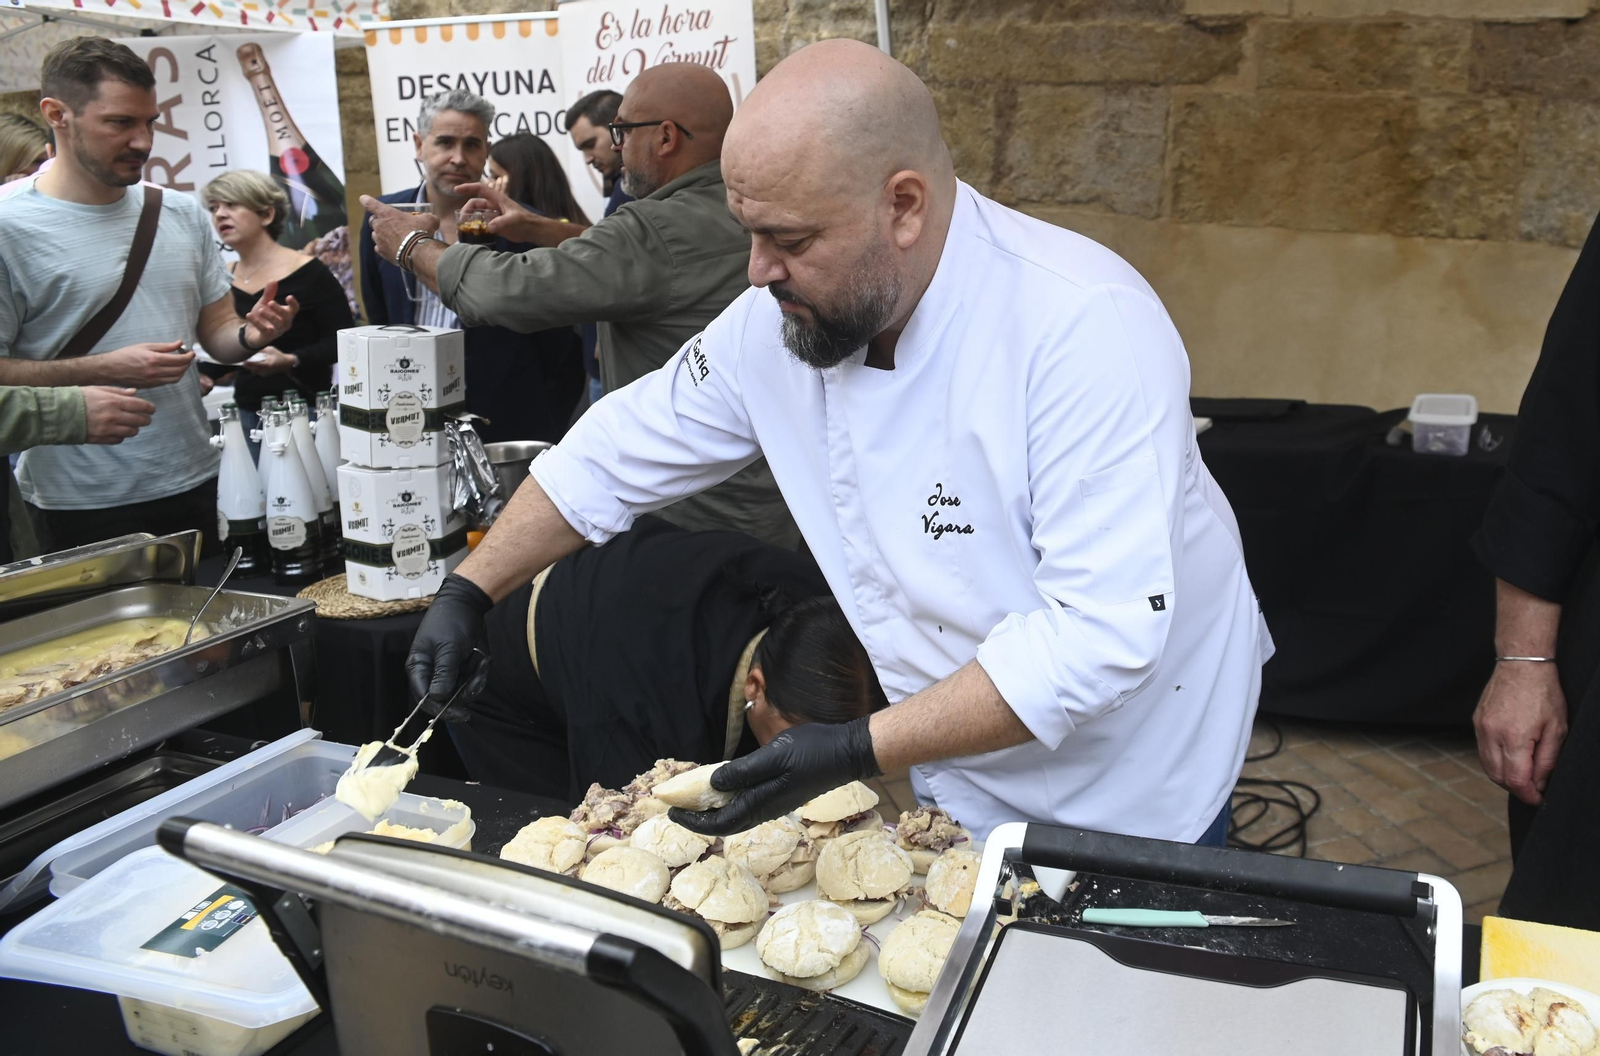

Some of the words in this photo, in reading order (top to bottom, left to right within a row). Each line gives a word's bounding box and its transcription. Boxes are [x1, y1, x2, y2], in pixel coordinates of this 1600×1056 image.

[595, 11, 625, 50] Es
[630, 8, 653, 39] la
[658, 3, 713, 36] hora
[397, 68, 556, 100] DESAYUNA
[586, 54, 615, 84] del
[927, 482, 961, 507] Jose
[921, 510, 975, 541] Vigara
